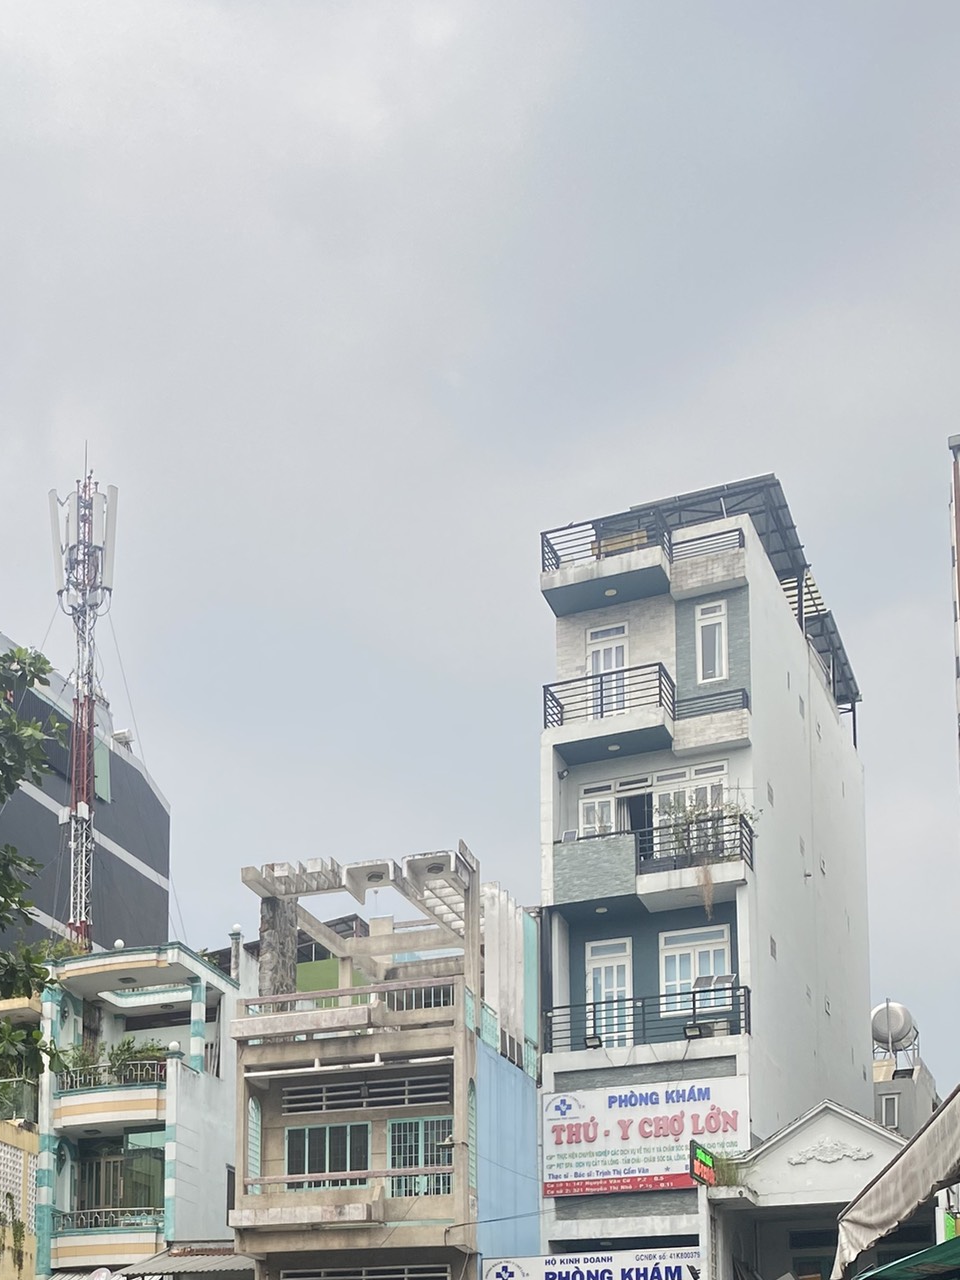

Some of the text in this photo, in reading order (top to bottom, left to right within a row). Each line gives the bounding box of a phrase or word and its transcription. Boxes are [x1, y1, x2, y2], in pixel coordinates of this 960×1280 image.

[608, 1085, 711, 1109] PHÒNG KHÁM
[552, 1104, 739, 1145] THÚ Y CHỢ LỚN
[545, 1256, 613, 1267] HỘ KINH DOANH
